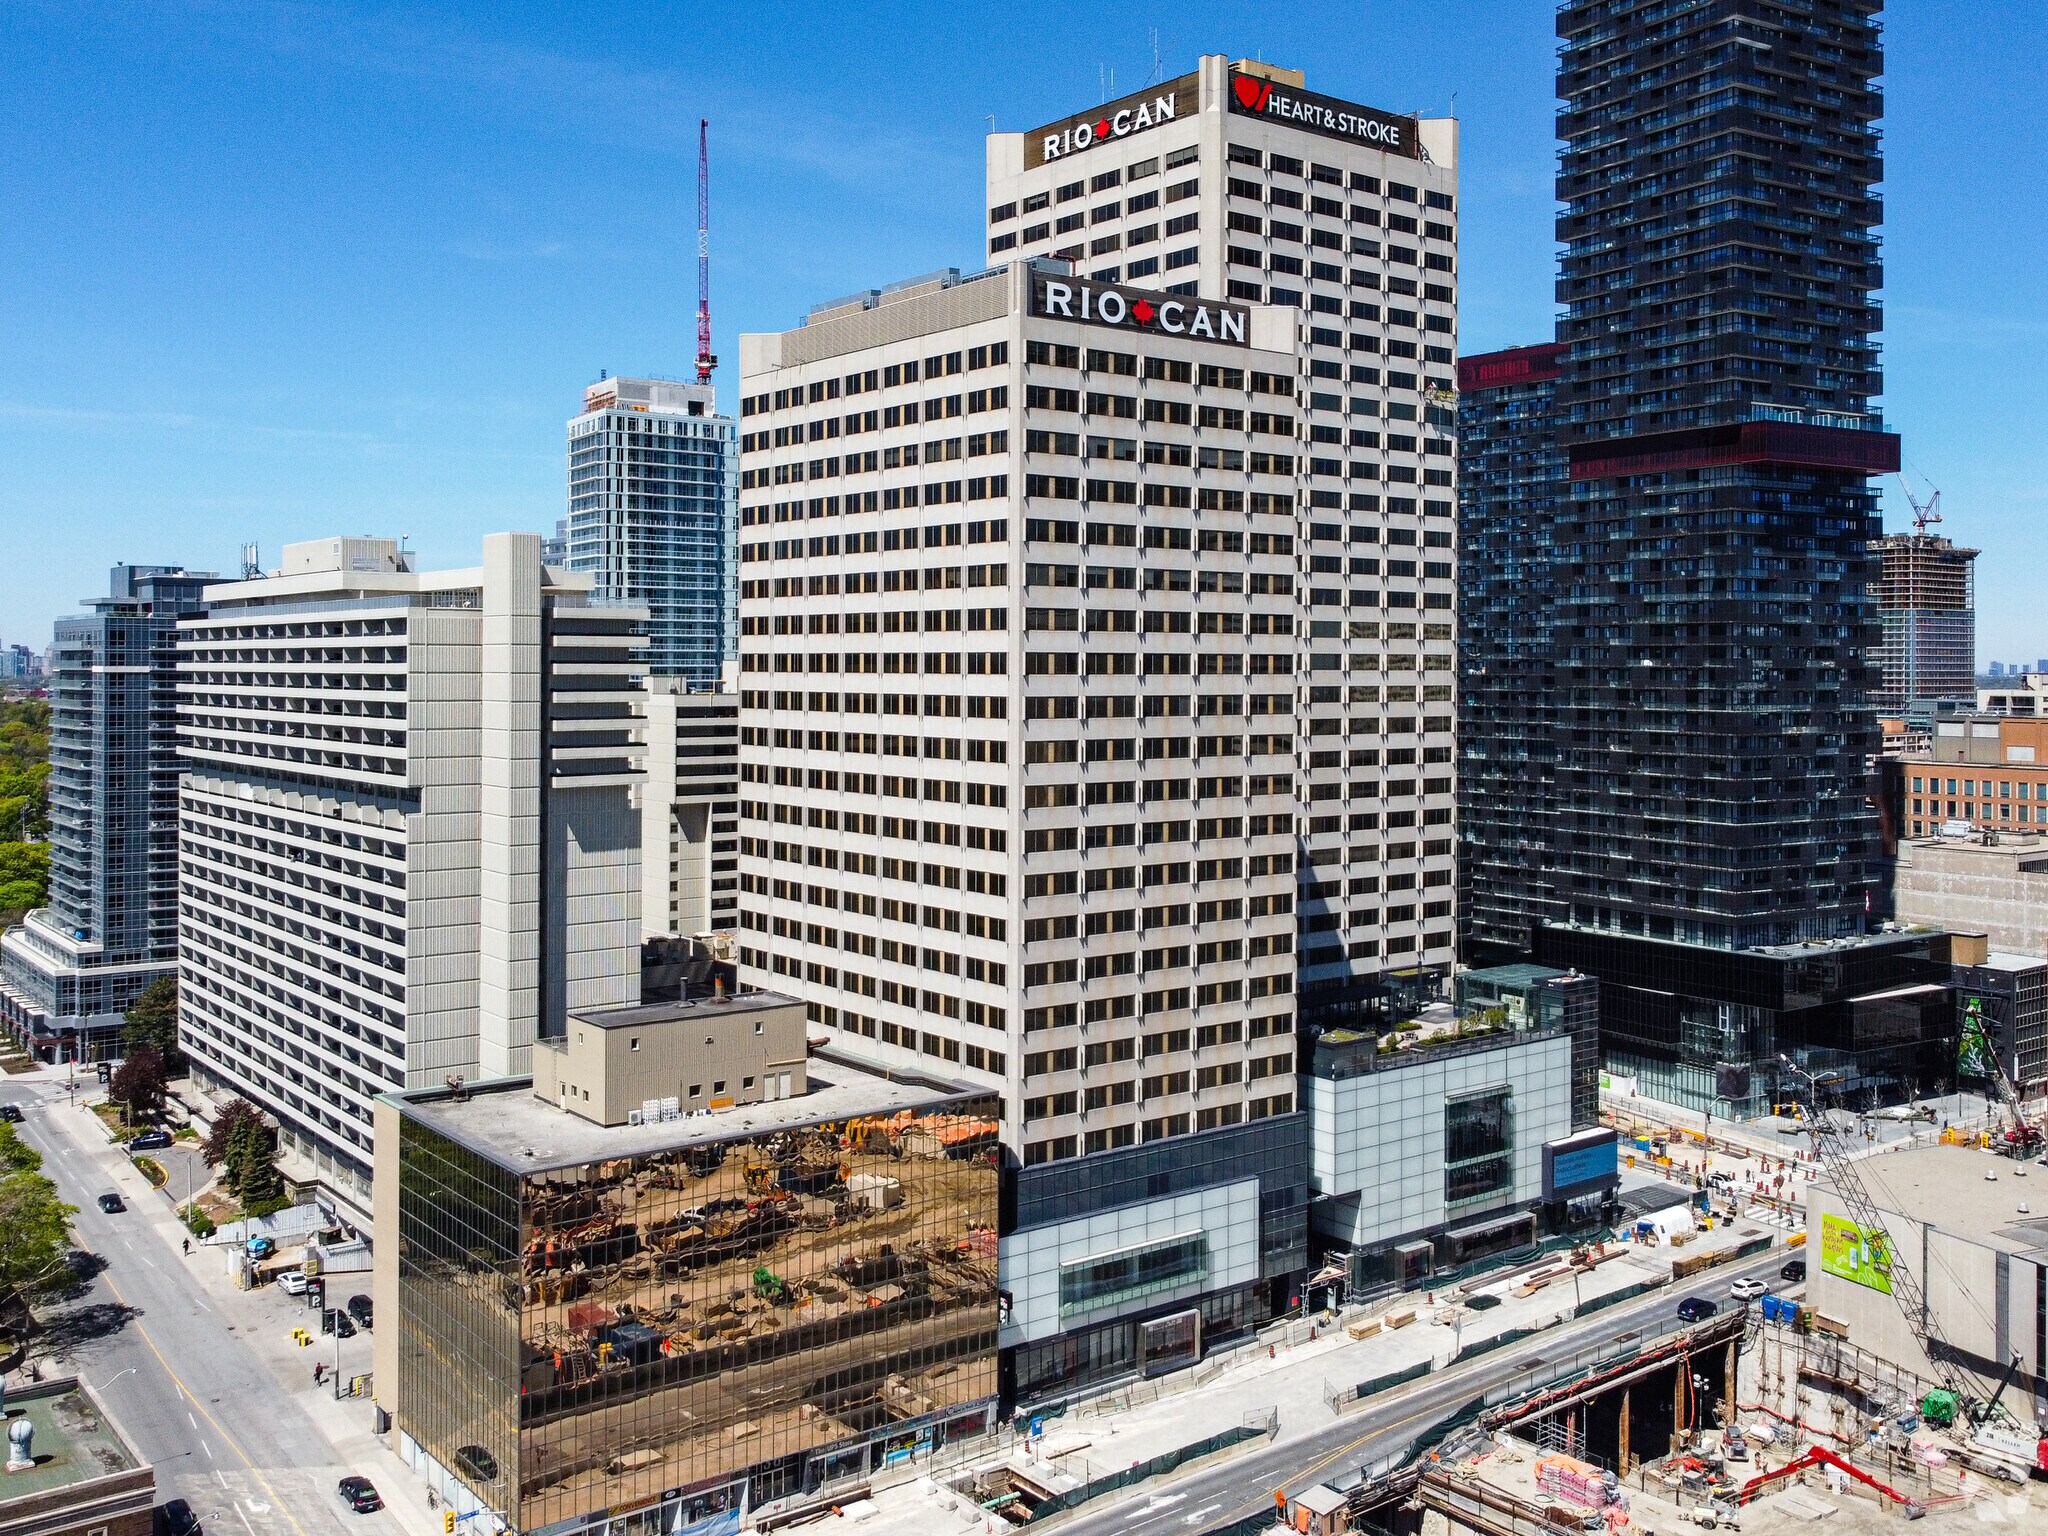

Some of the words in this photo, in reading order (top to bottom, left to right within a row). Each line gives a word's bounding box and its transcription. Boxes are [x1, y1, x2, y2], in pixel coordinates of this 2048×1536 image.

[1043, 121, 1093, 161] RIO
[1112, 92, 1177, 138] CAN
[1045, 280, 1127, 324] RIO
[1159, 300, 1246, 343] CAN
[1452, 1160, 1499, 1179] WINNERS
[815, 1448, 826, 1456] The
[827, 1443, 838, 1453] UPS
[839, 1440, 854, 1449] Store
[619, 1495, 657, 1512] CONVENIENCE
